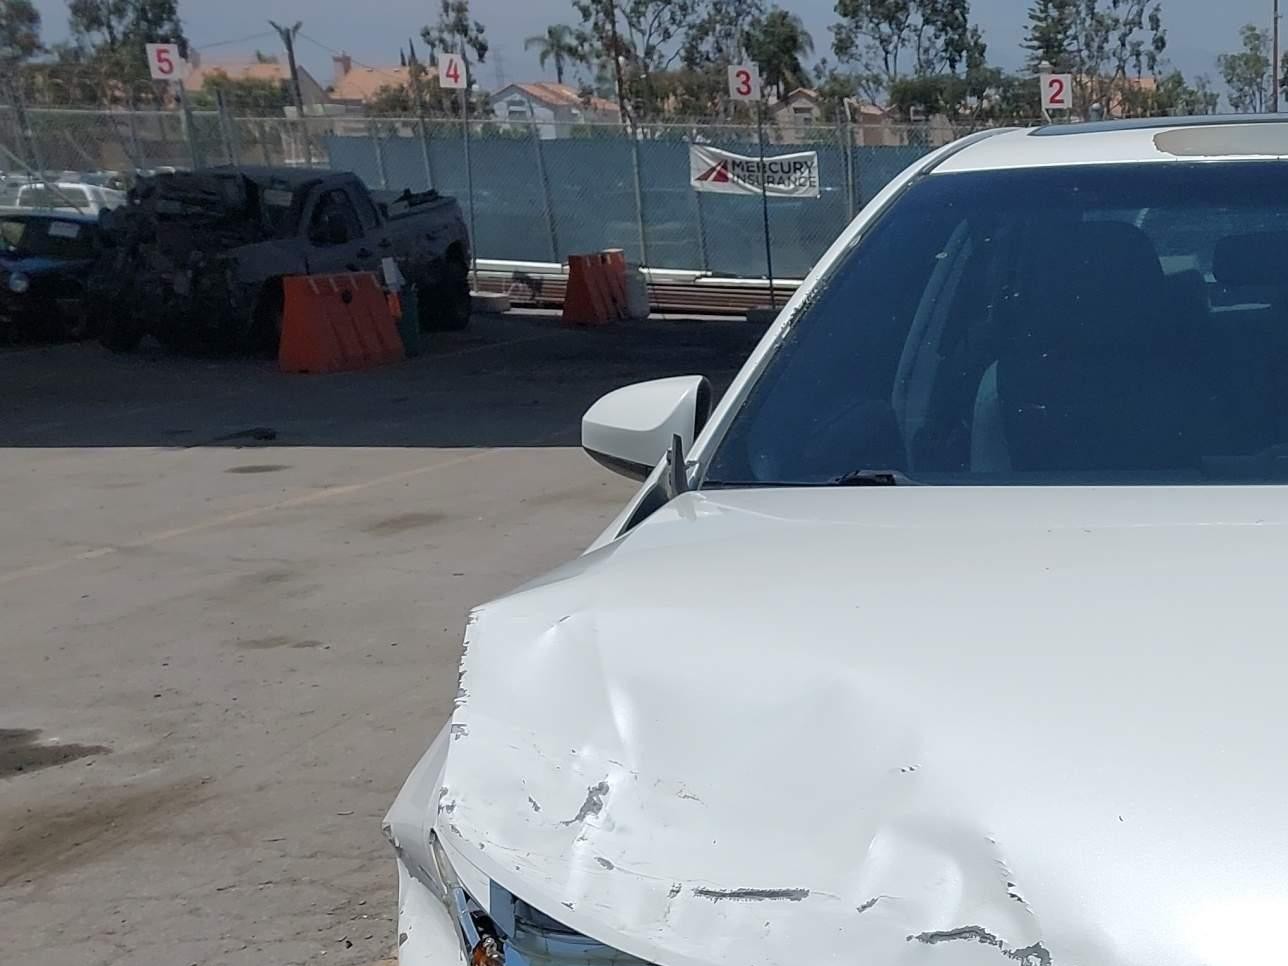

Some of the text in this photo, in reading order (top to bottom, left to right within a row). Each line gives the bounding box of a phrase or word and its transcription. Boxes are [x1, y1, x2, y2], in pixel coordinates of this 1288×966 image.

[156, 48, 174, 75] 5
[445, 57, 460, 84] 4
[735, 70, 752, 96] 3
[1048, 78, 1065, 104] 2
[731, 159, 815, 174] MERCURY
